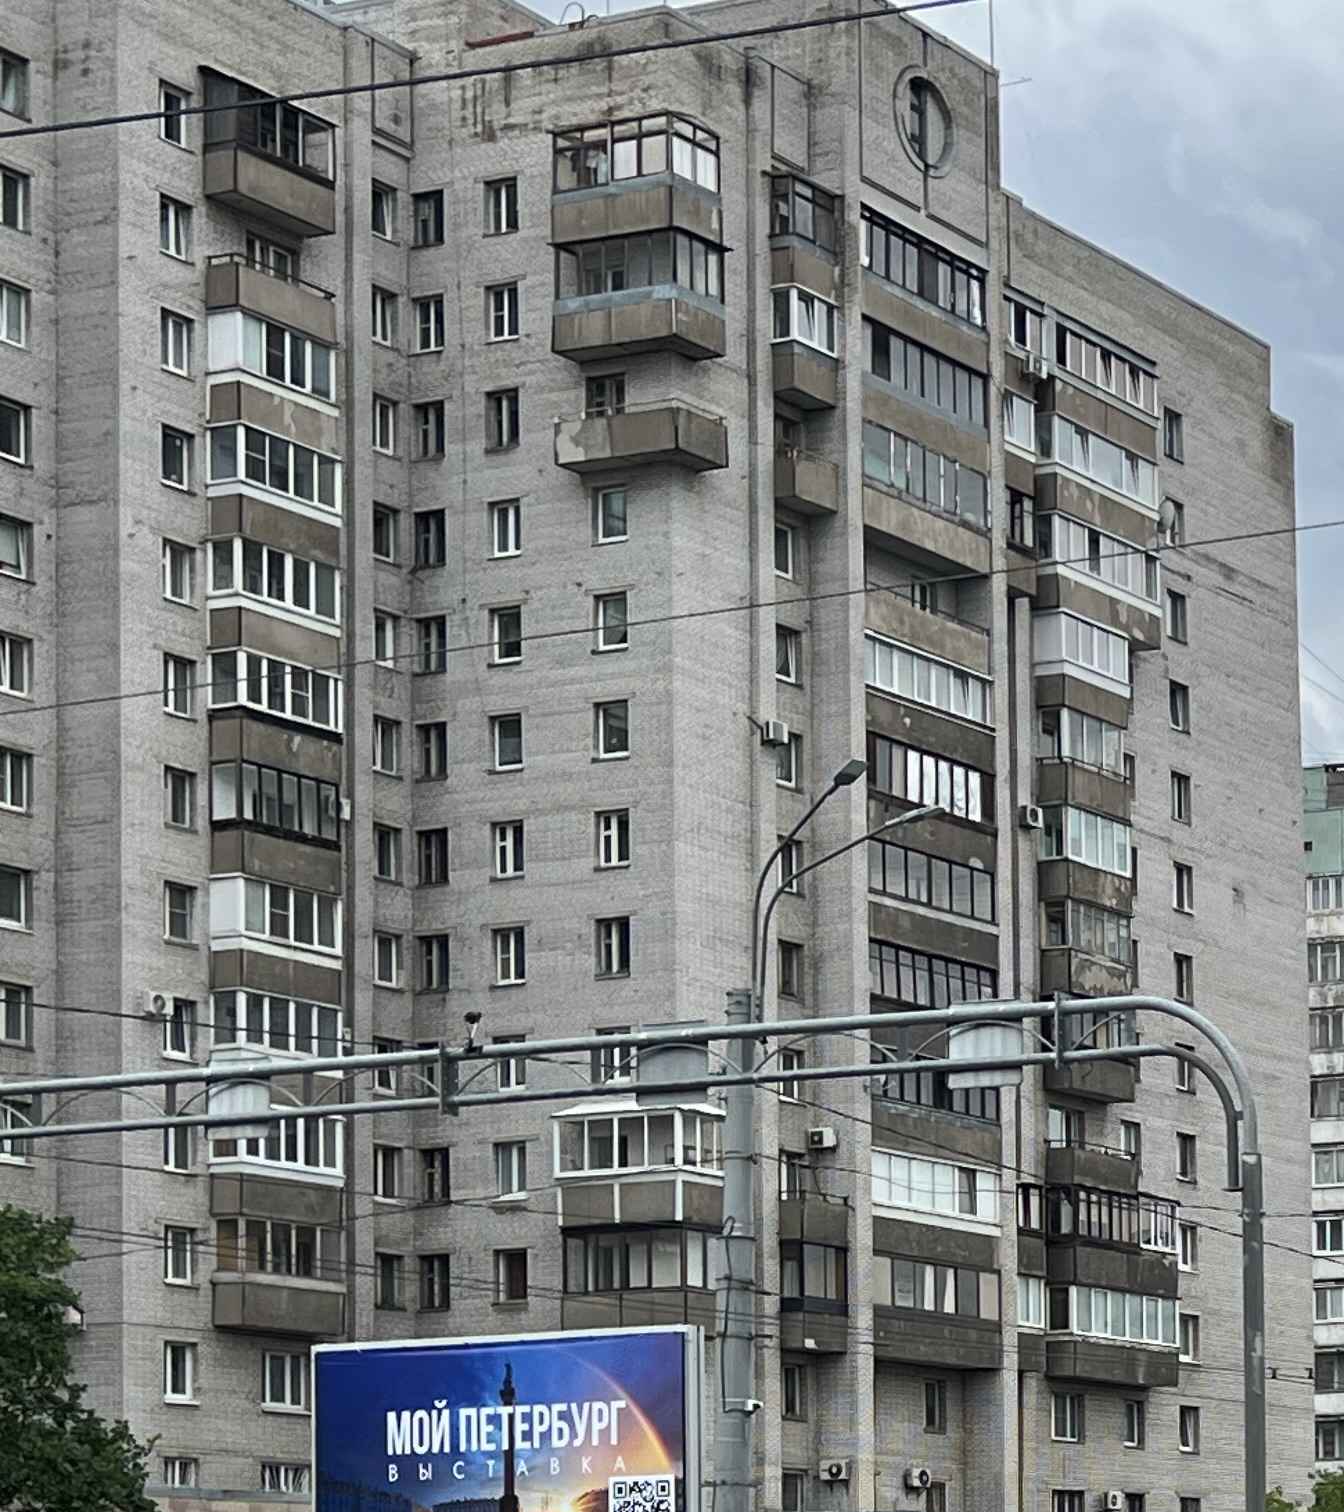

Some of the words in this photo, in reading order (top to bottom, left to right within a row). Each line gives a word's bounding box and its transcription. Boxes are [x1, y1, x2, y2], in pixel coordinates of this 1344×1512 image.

[386, 1400, 450, 1455] МОЙ
[458, 1400, 627, 1452] ПЕТЕРБУРГ
[387, 1456, 626, 1482] ВЫСТАВКА
